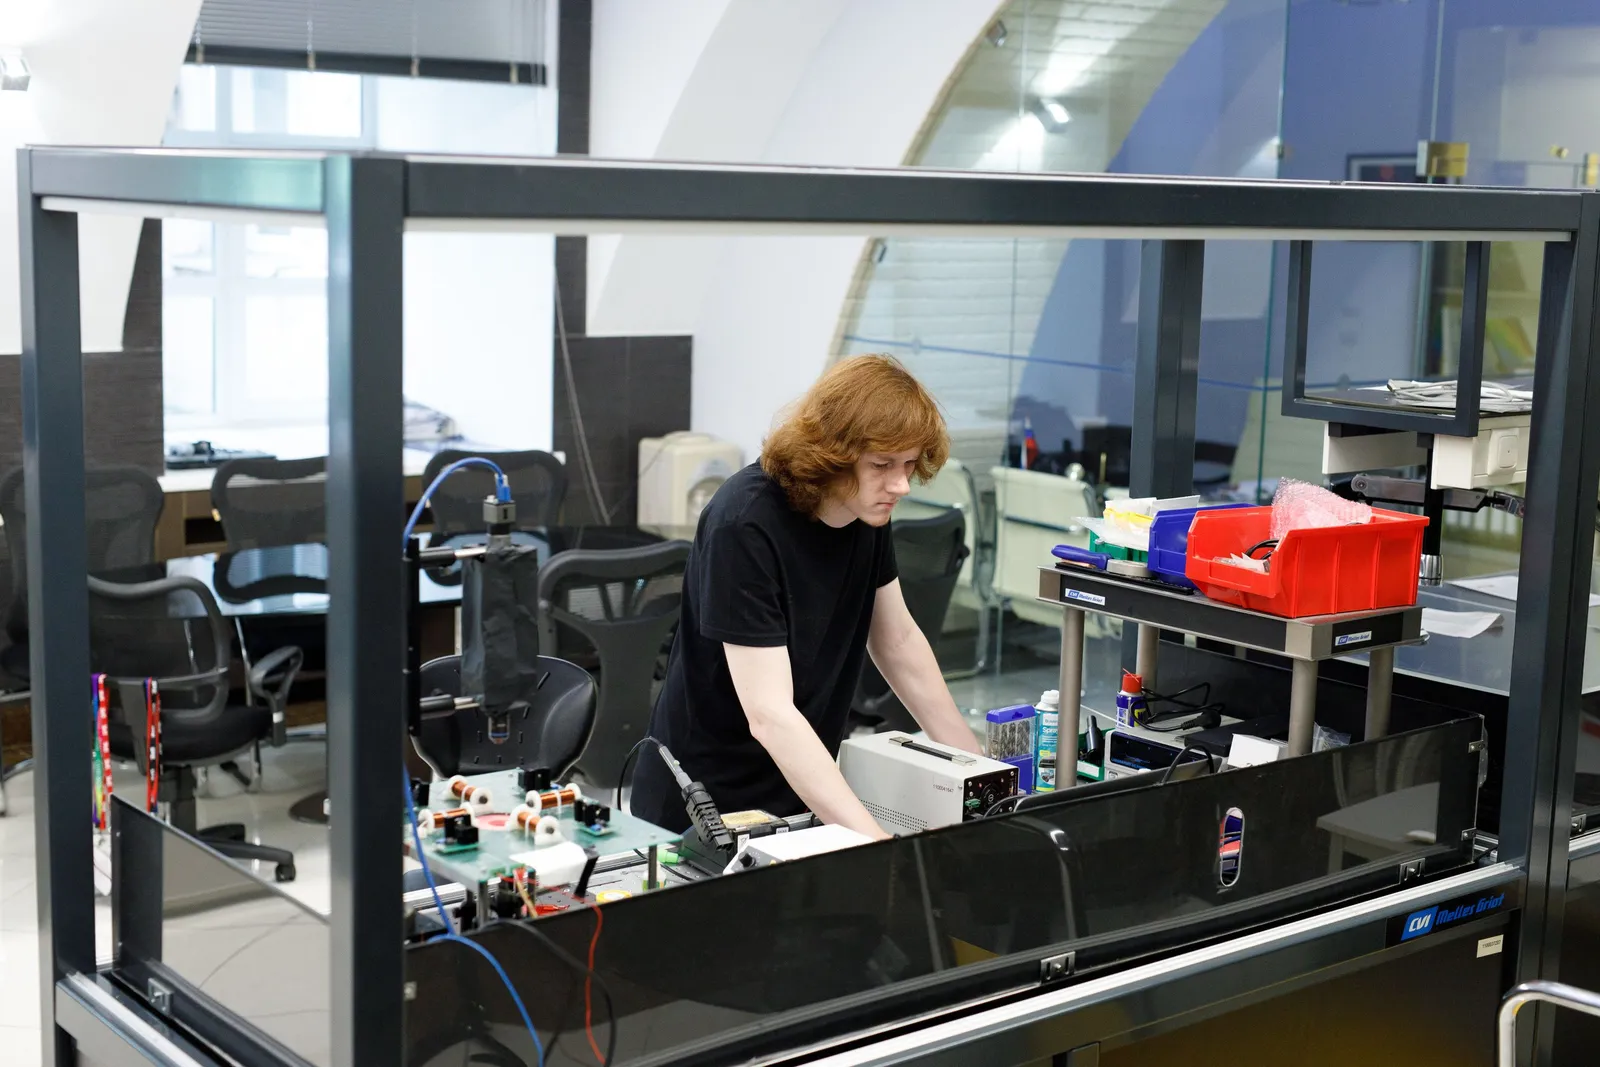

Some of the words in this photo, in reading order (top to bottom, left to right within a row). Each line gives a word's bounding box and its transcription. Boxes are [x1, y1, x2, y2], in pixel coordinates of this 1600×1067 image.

[1408, 913, 1432, 933] CVI
[1436, 905, 1475, 925] Melles
[1476, 893, 1505, 913] Griot
